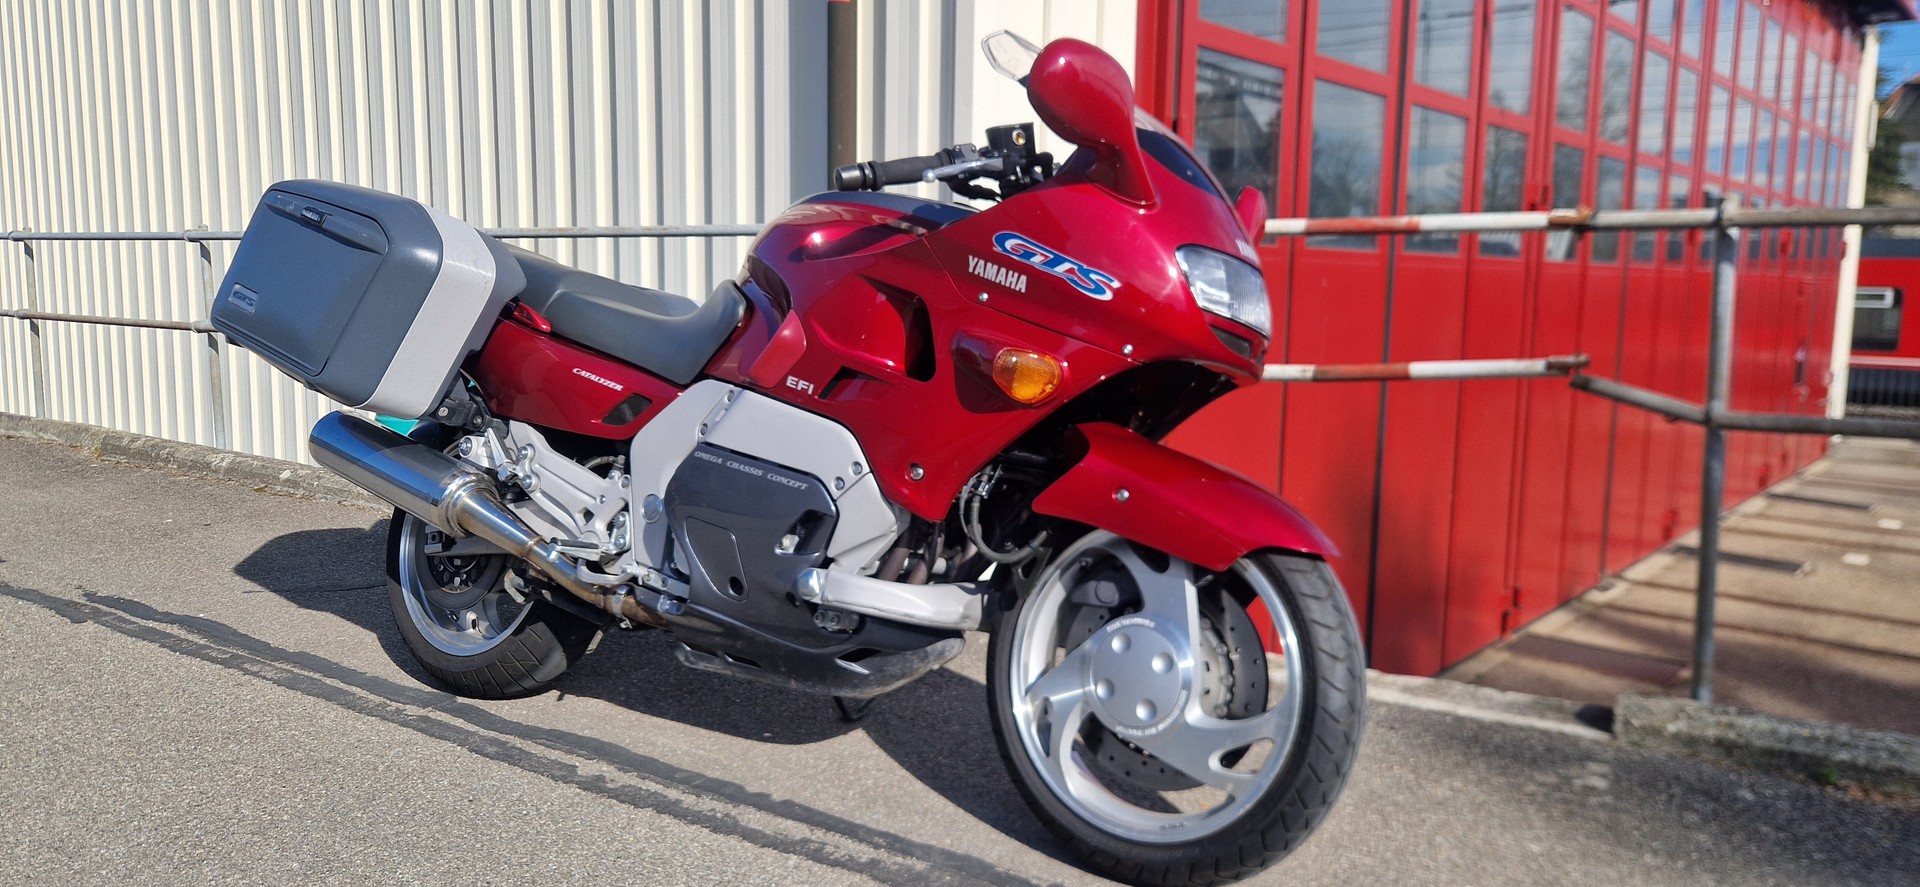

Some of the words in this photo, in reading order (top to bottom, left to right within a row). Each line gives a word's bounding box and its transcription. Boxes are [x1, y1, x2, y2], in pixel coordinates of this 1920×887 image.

[968, 255, 1028, 293] YAMAHA
[992, 230, 1122, 301] GTS
[233, 290, 256, 307] GTS
[572, 368, 624, 391] CATALYZER
[786, 375, 814, 395] EFI
[694, 451, 723, 464] OMEGA
[726, 460, 764, 476] CHASSIS
[767, 473, 808, 490] CONCEPT
